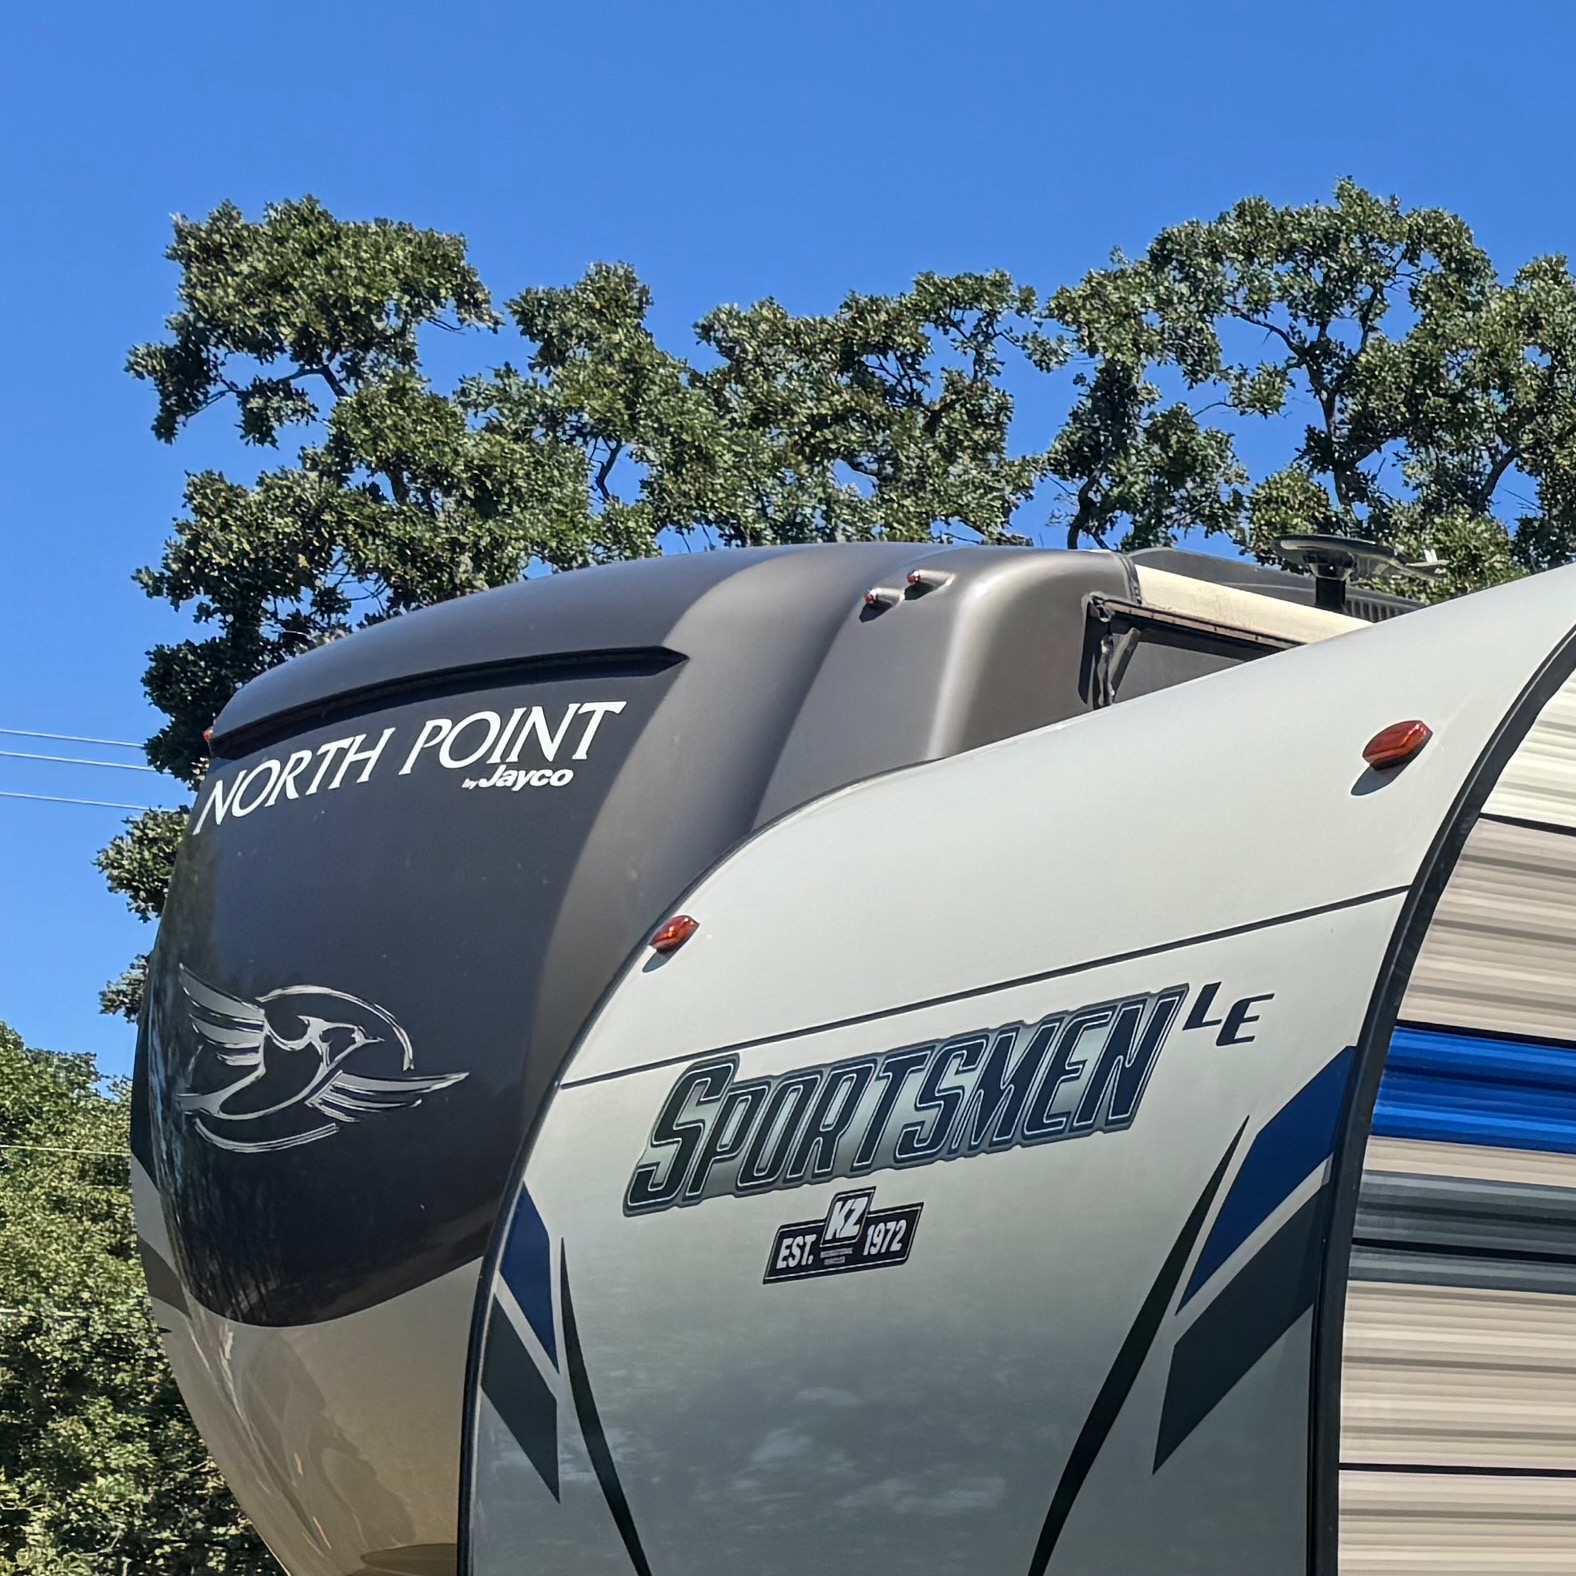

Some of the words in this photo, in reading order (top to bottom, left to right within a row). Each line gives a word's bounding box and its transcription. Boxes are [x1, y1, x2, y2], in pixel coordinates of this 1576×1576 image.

[193, 727, 396, 835] NORTH
[398, 700, 627, 776] POINT
[476, 764, 574, 792] Jayco
[624, 983, 1190, 1217] SPORTSMEN
[1182, 981, 1275, 1047] LE
[824, 1196, 869, 1241] KZ
[775, 1233, 817, 1270] EST.
[862, 1219, 907, 1256] 1972
